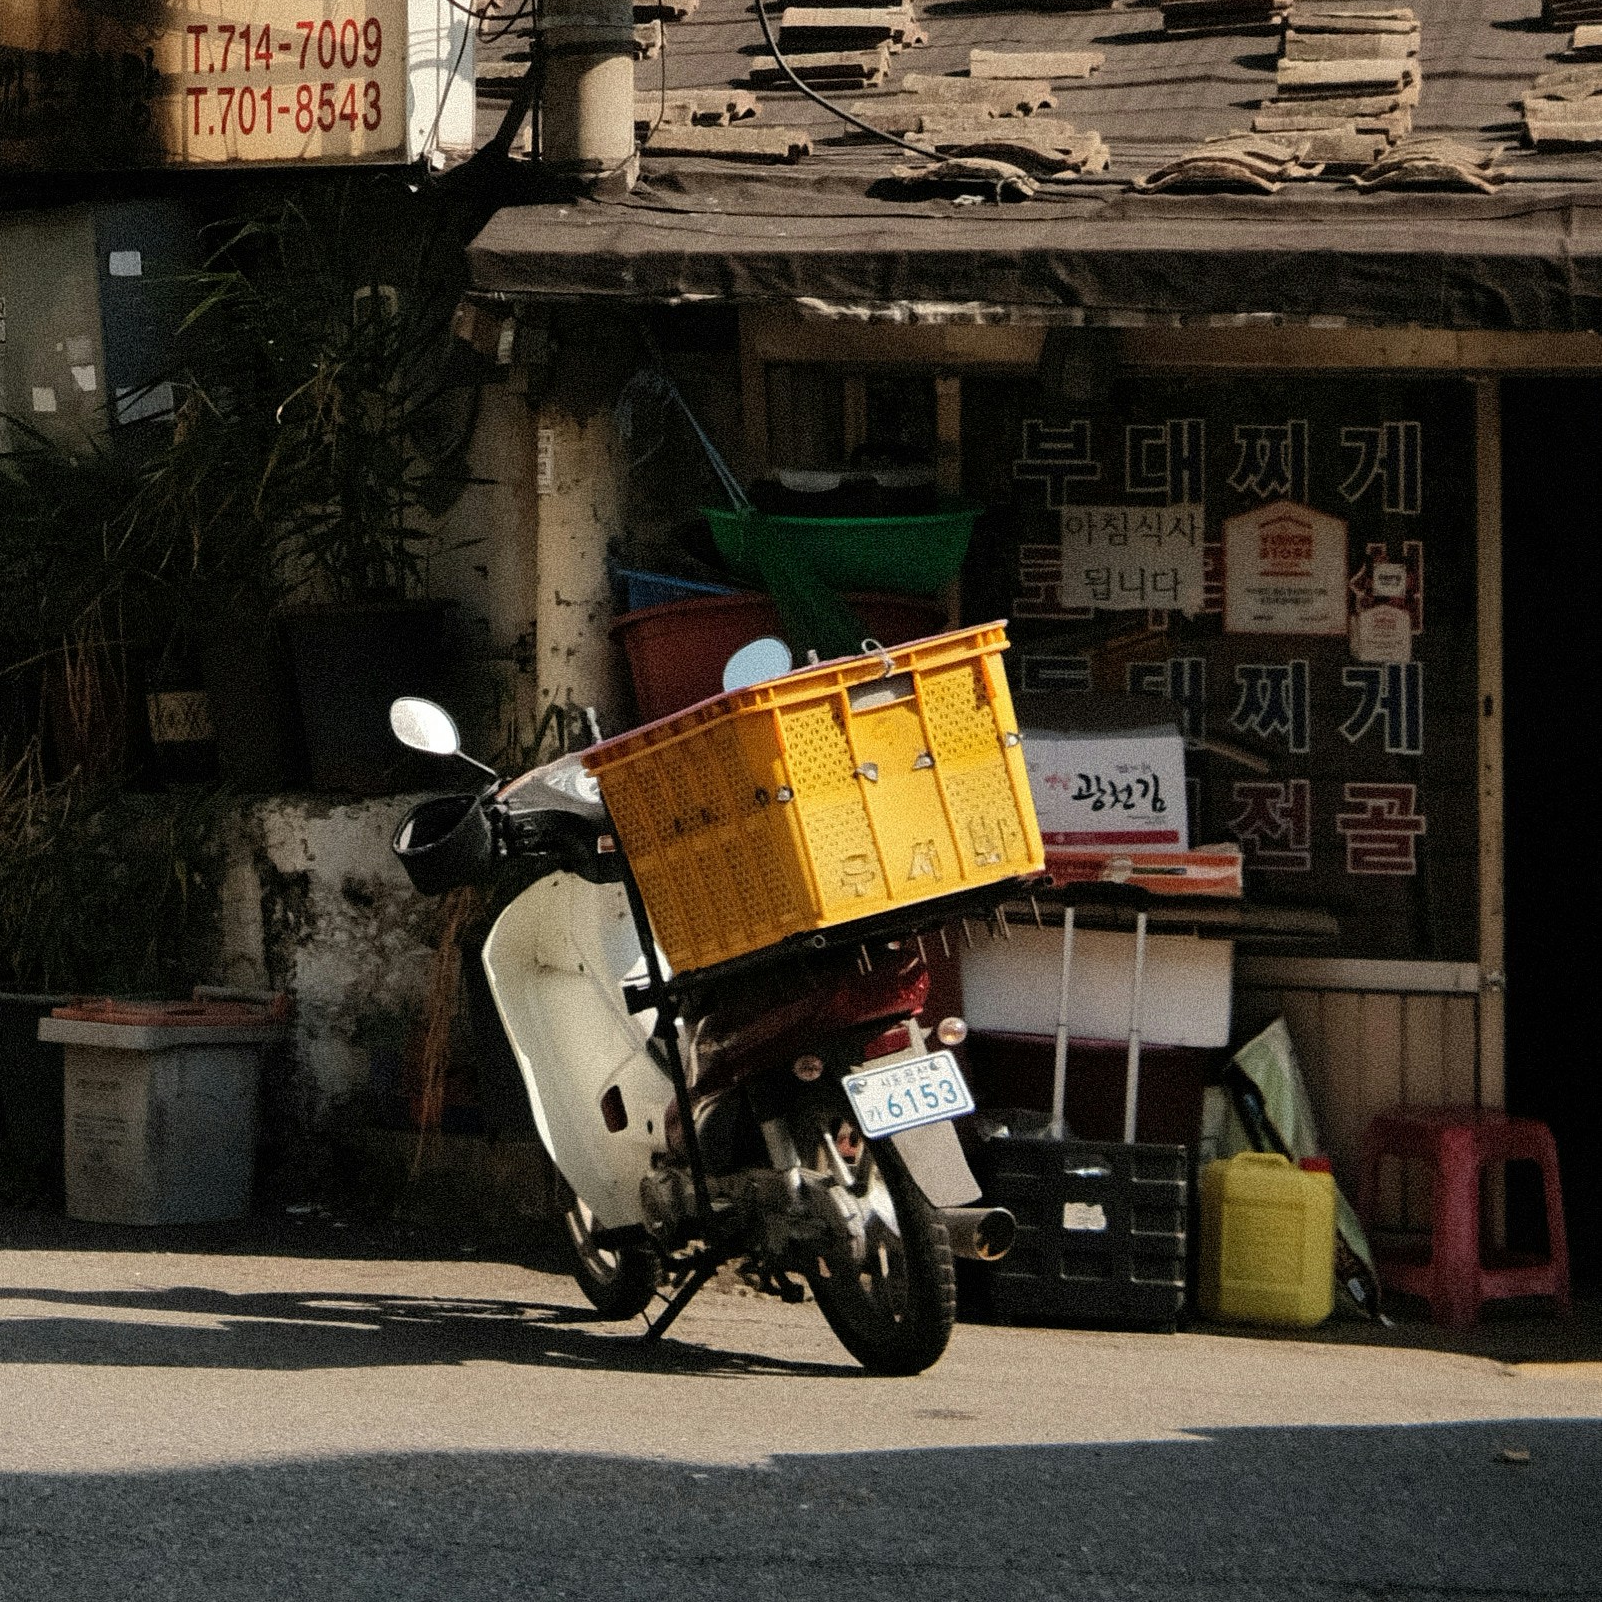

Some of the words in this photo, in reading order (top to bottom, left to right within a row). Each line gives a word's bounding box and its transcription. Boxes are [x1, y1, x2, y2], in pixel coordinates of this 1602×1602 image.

[186, 17, 383, 74] T.714-7009
[186, 79, 383, 137] T.701-8543
[1013, 419, 1422, 514] 부대찌게
[1064, 510, 1202, 548] 아침식사
[1082, 564, 1184, 602] 됩니다
[1072, 773, 1167, 813] 광천김
[1188, 779, 1427, 876] 전골
[887, 1079, 958, 1118] 6153
